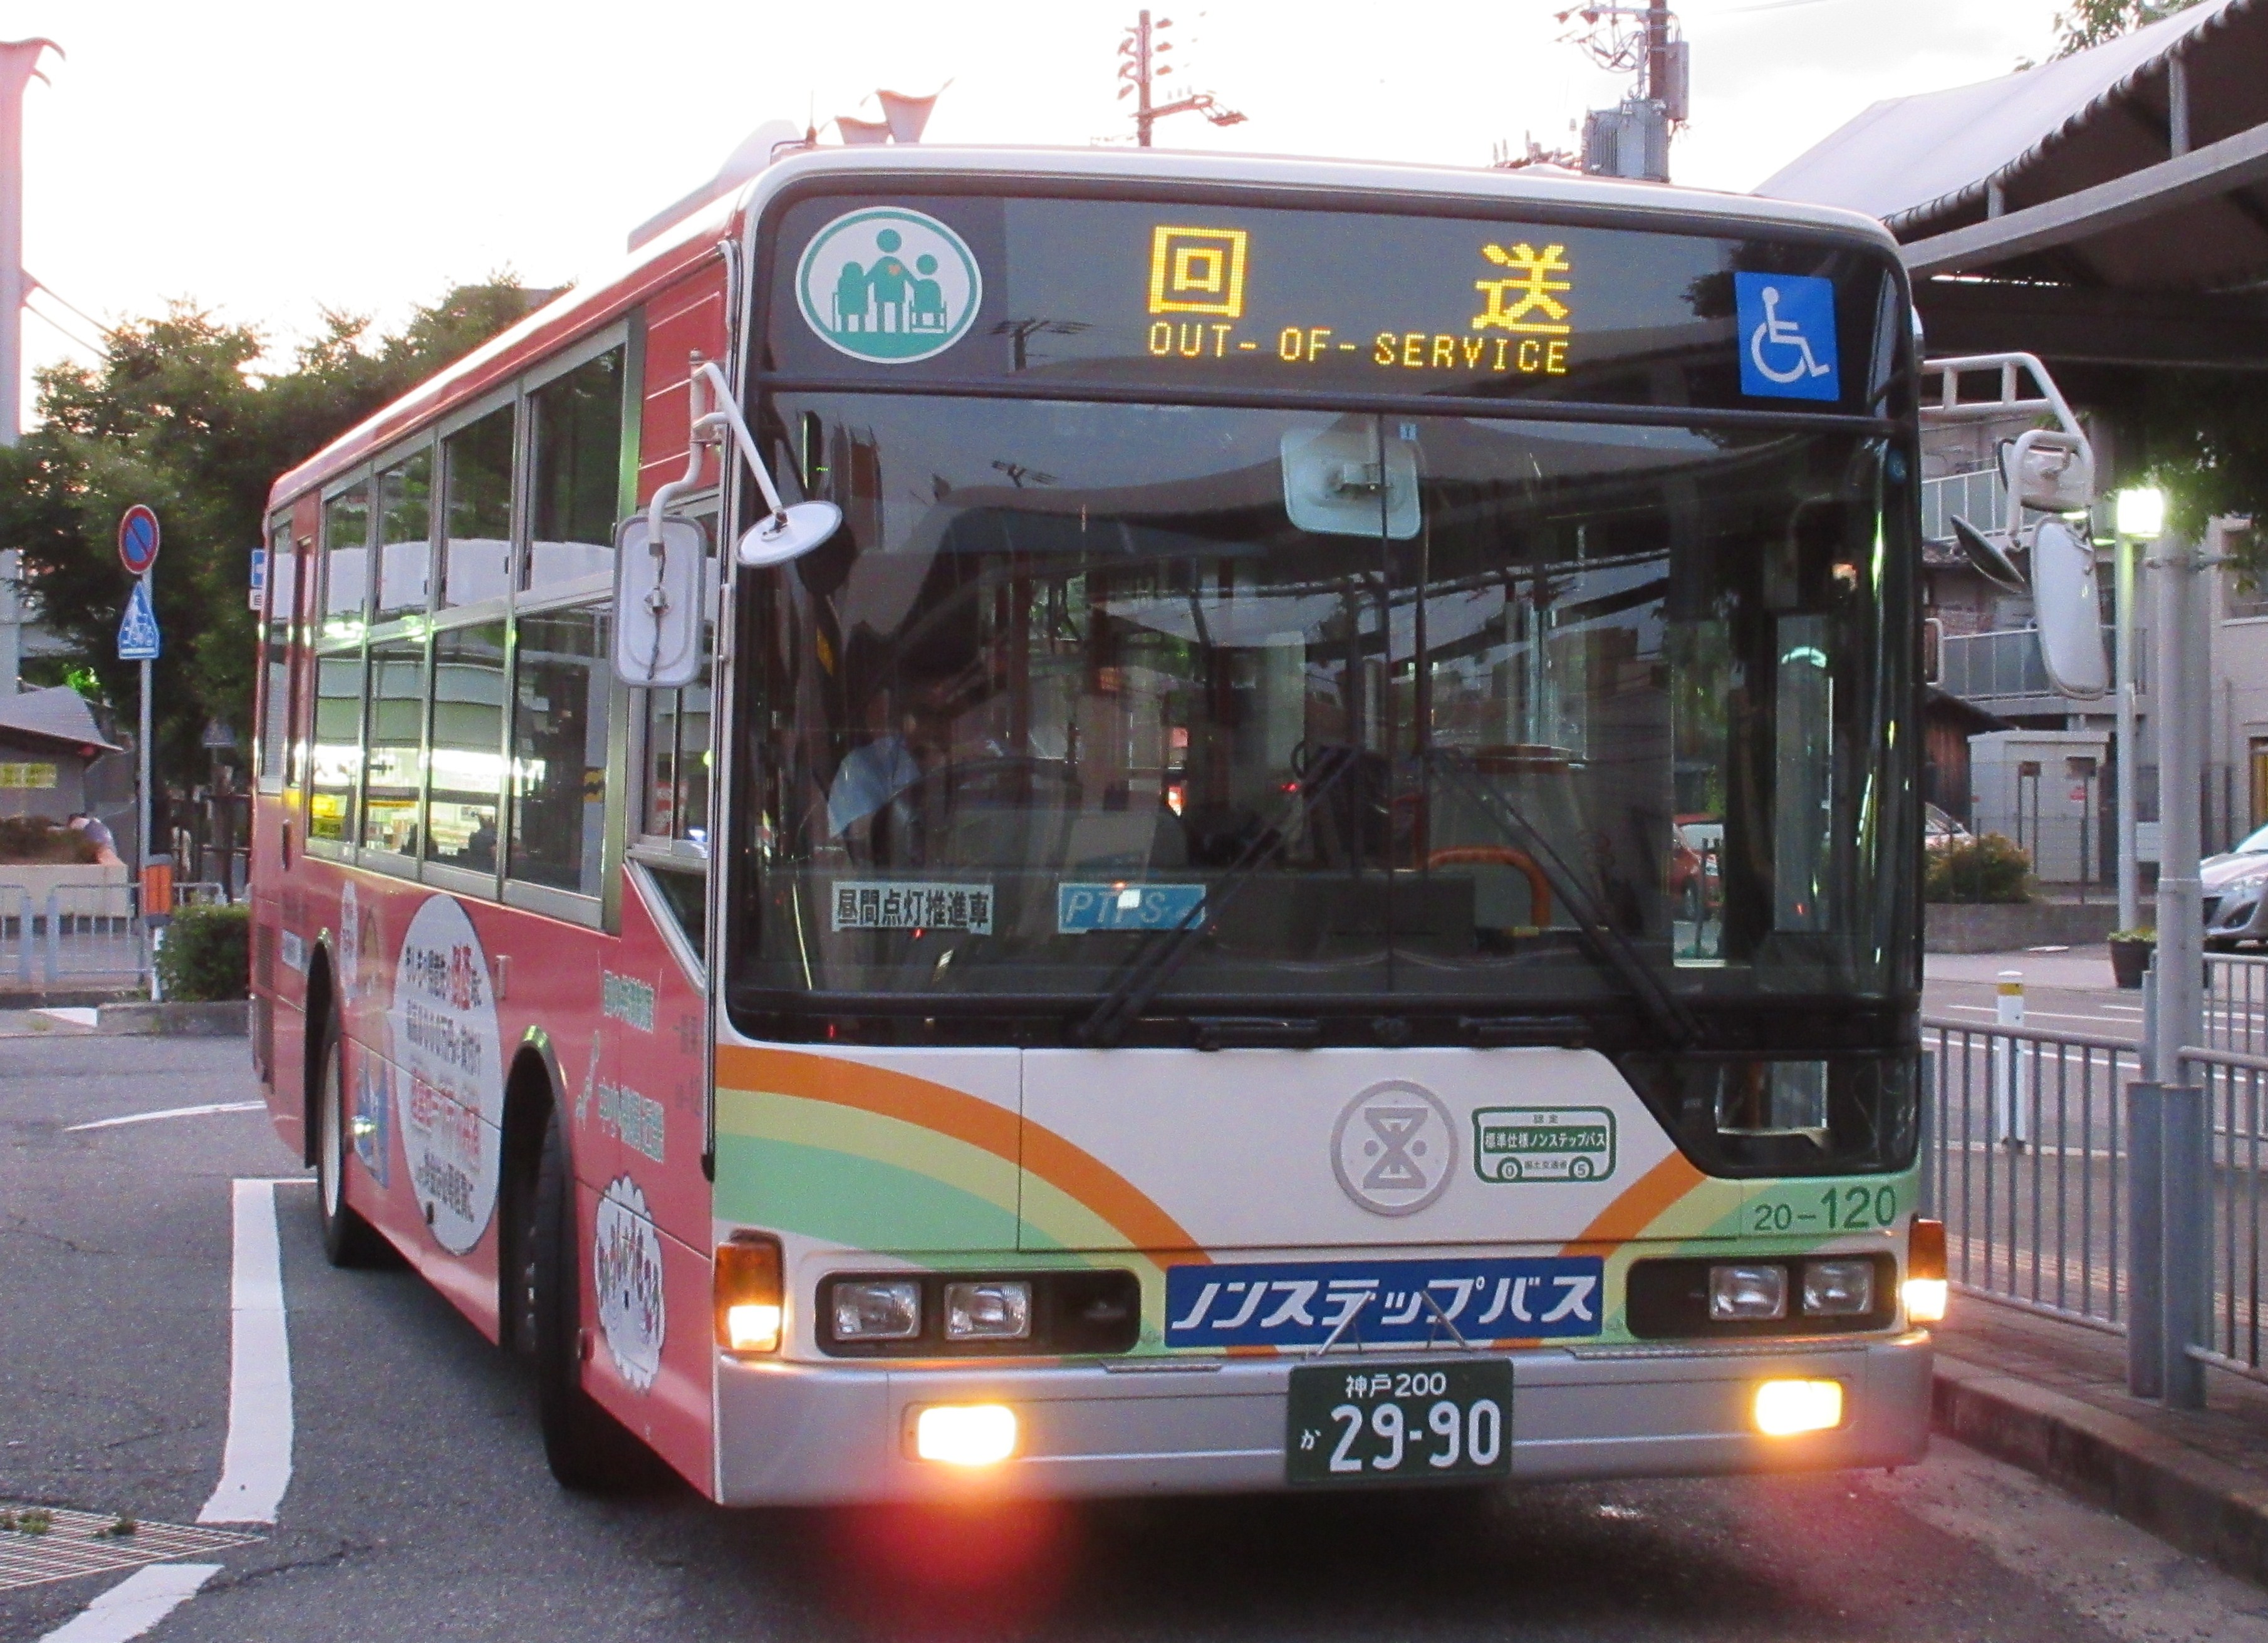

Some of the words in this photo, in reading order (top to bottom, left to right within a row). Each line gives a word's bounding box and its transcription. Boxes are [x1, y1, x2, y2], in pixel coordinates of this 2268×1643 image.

[1148, 225, 1247, 318] 回
[1472, 242, 1573, 334] 送
[838, 888, 989, 927] 昼間点灯推進車
[1754, 1185, 1896, 1231] 20-120
[1171, 1275, 1597, 1330] ノンステップバス
[1329, 1398, 1501, 1473] 29-90
